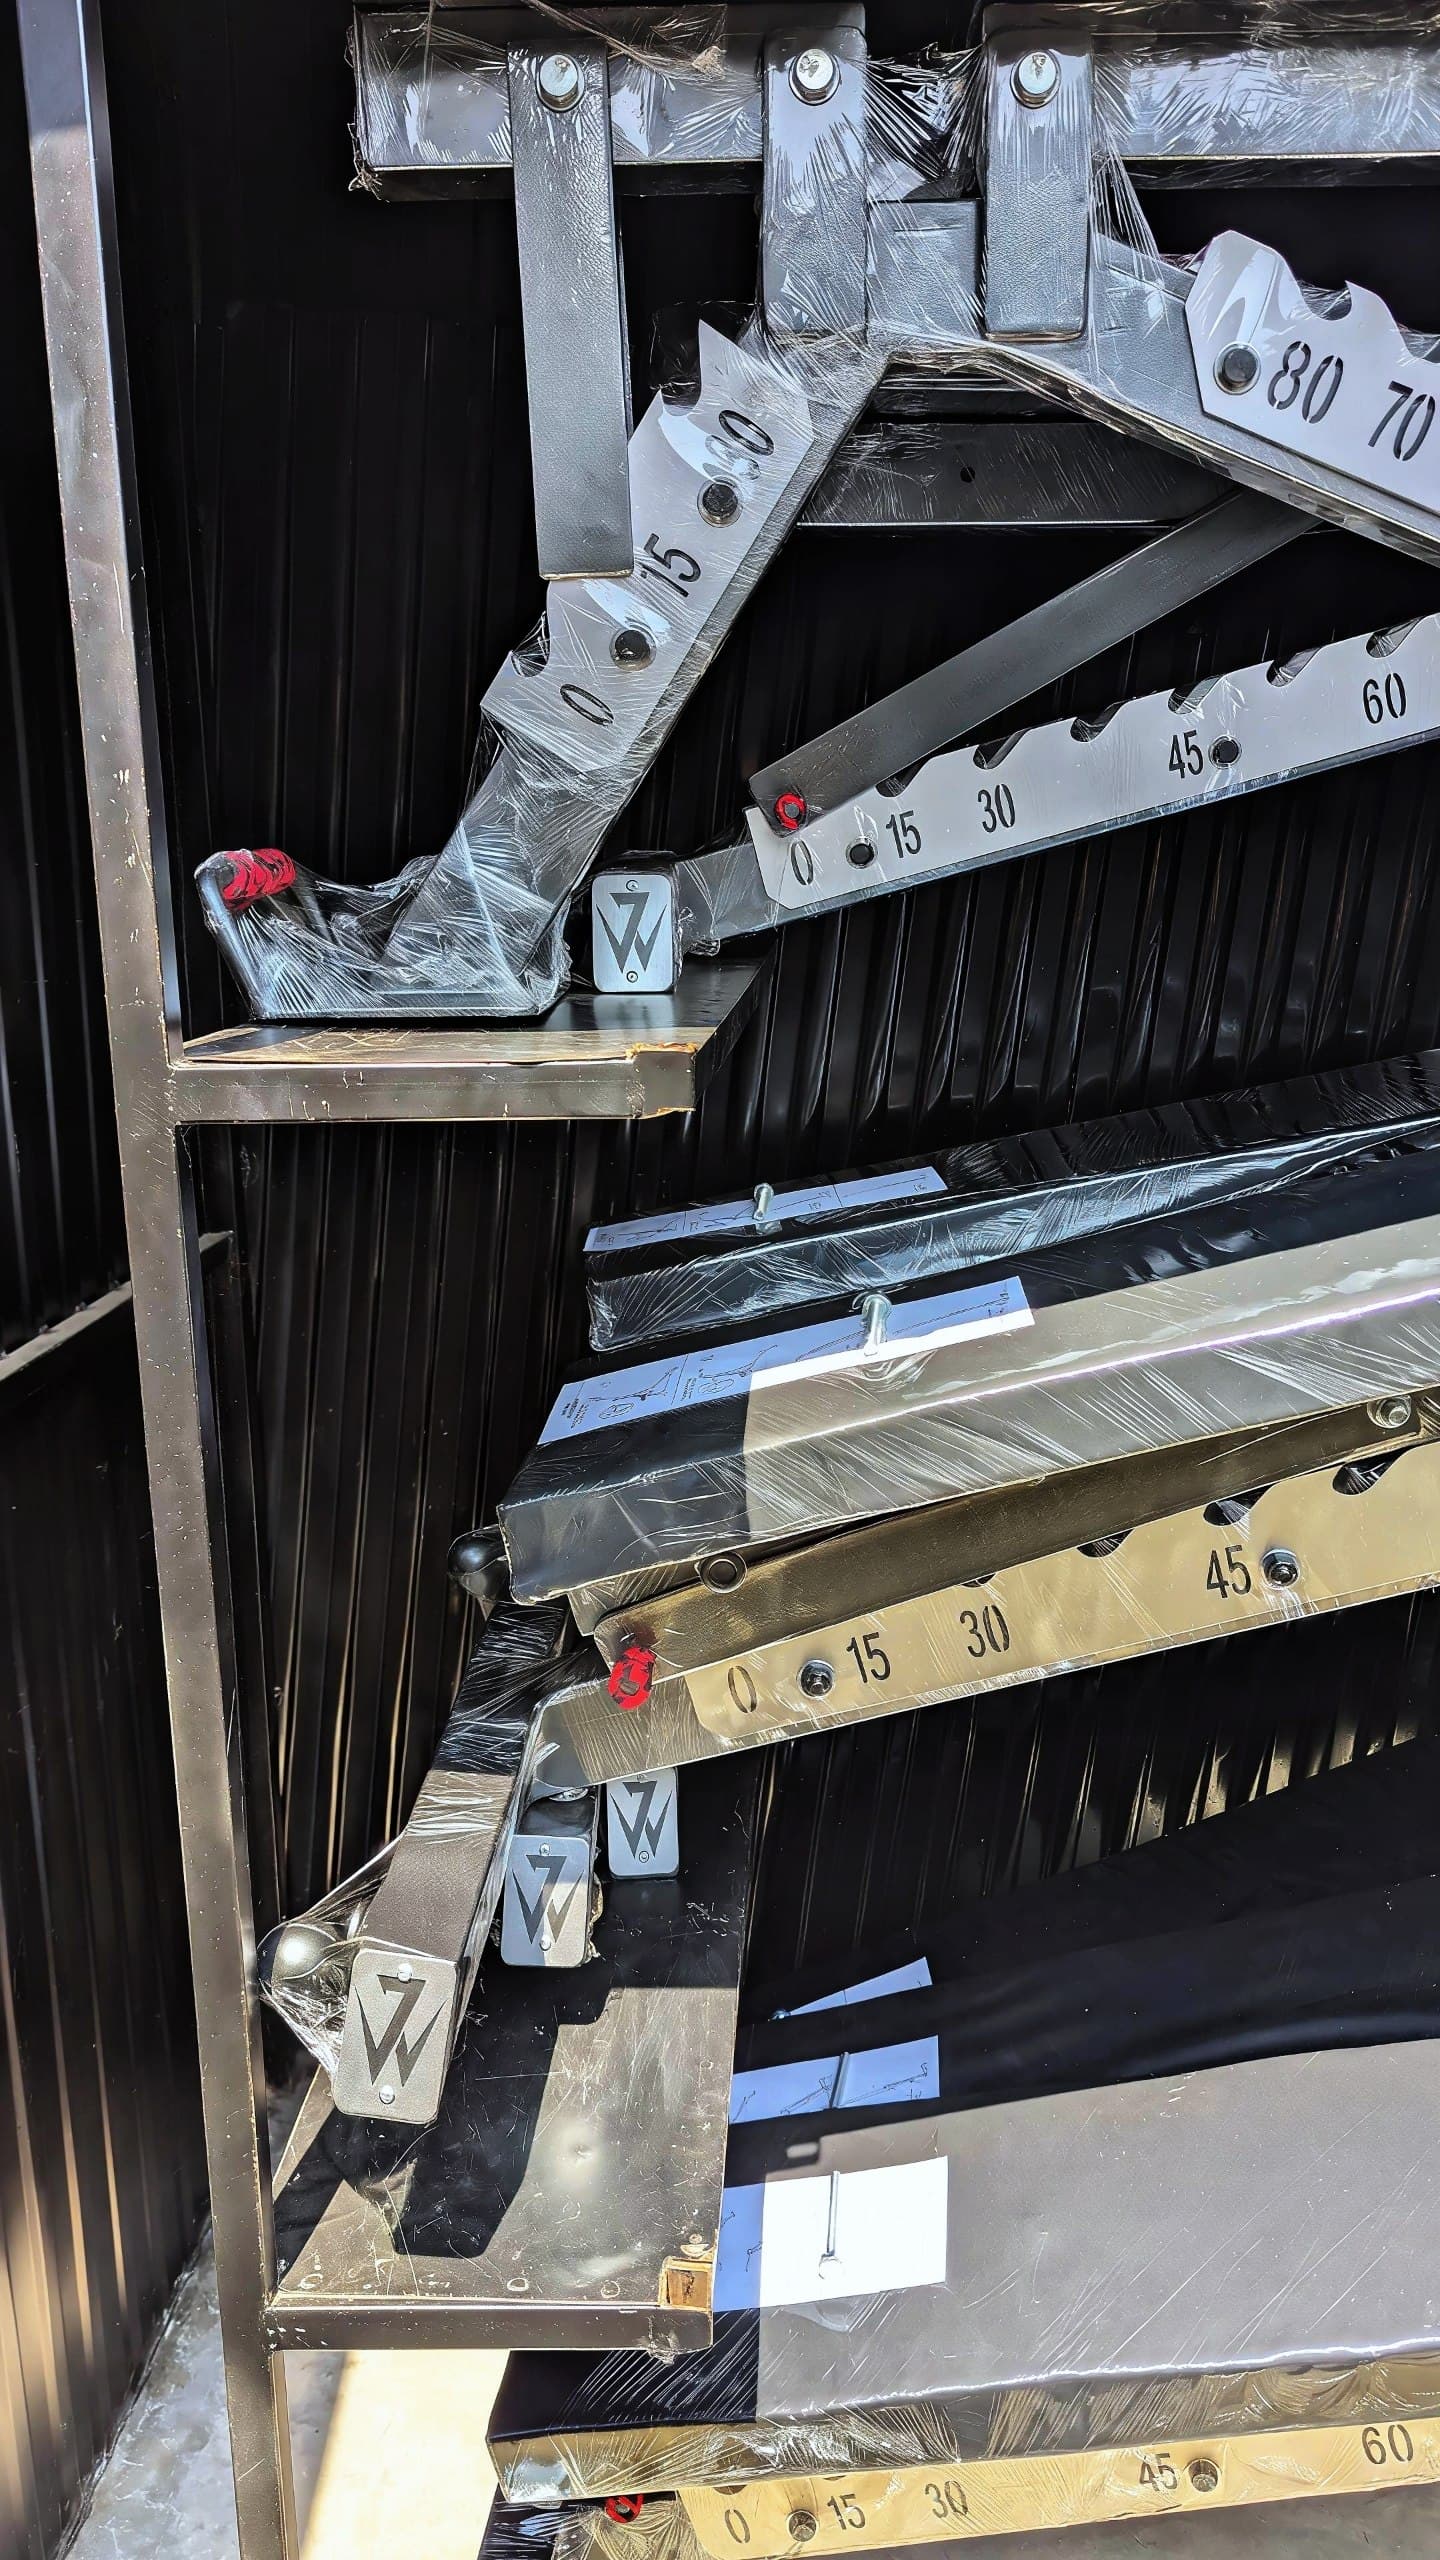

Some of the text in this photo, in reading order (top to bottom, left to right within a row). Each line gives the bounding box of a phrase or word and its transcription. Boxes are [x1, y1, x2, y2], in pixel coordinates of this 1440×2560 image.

[1267, 340, 1436, 462] 80 70
[559, 682, 614, 726] 0
[640, 533, 702, 598] 15
[789, 672, 1408, 886] 0 15 30 45 60
[727, 1545, 1252, 1713] 0 15 30 45
[724, 2423, 1415, 2544] 0 15 30 45 60
